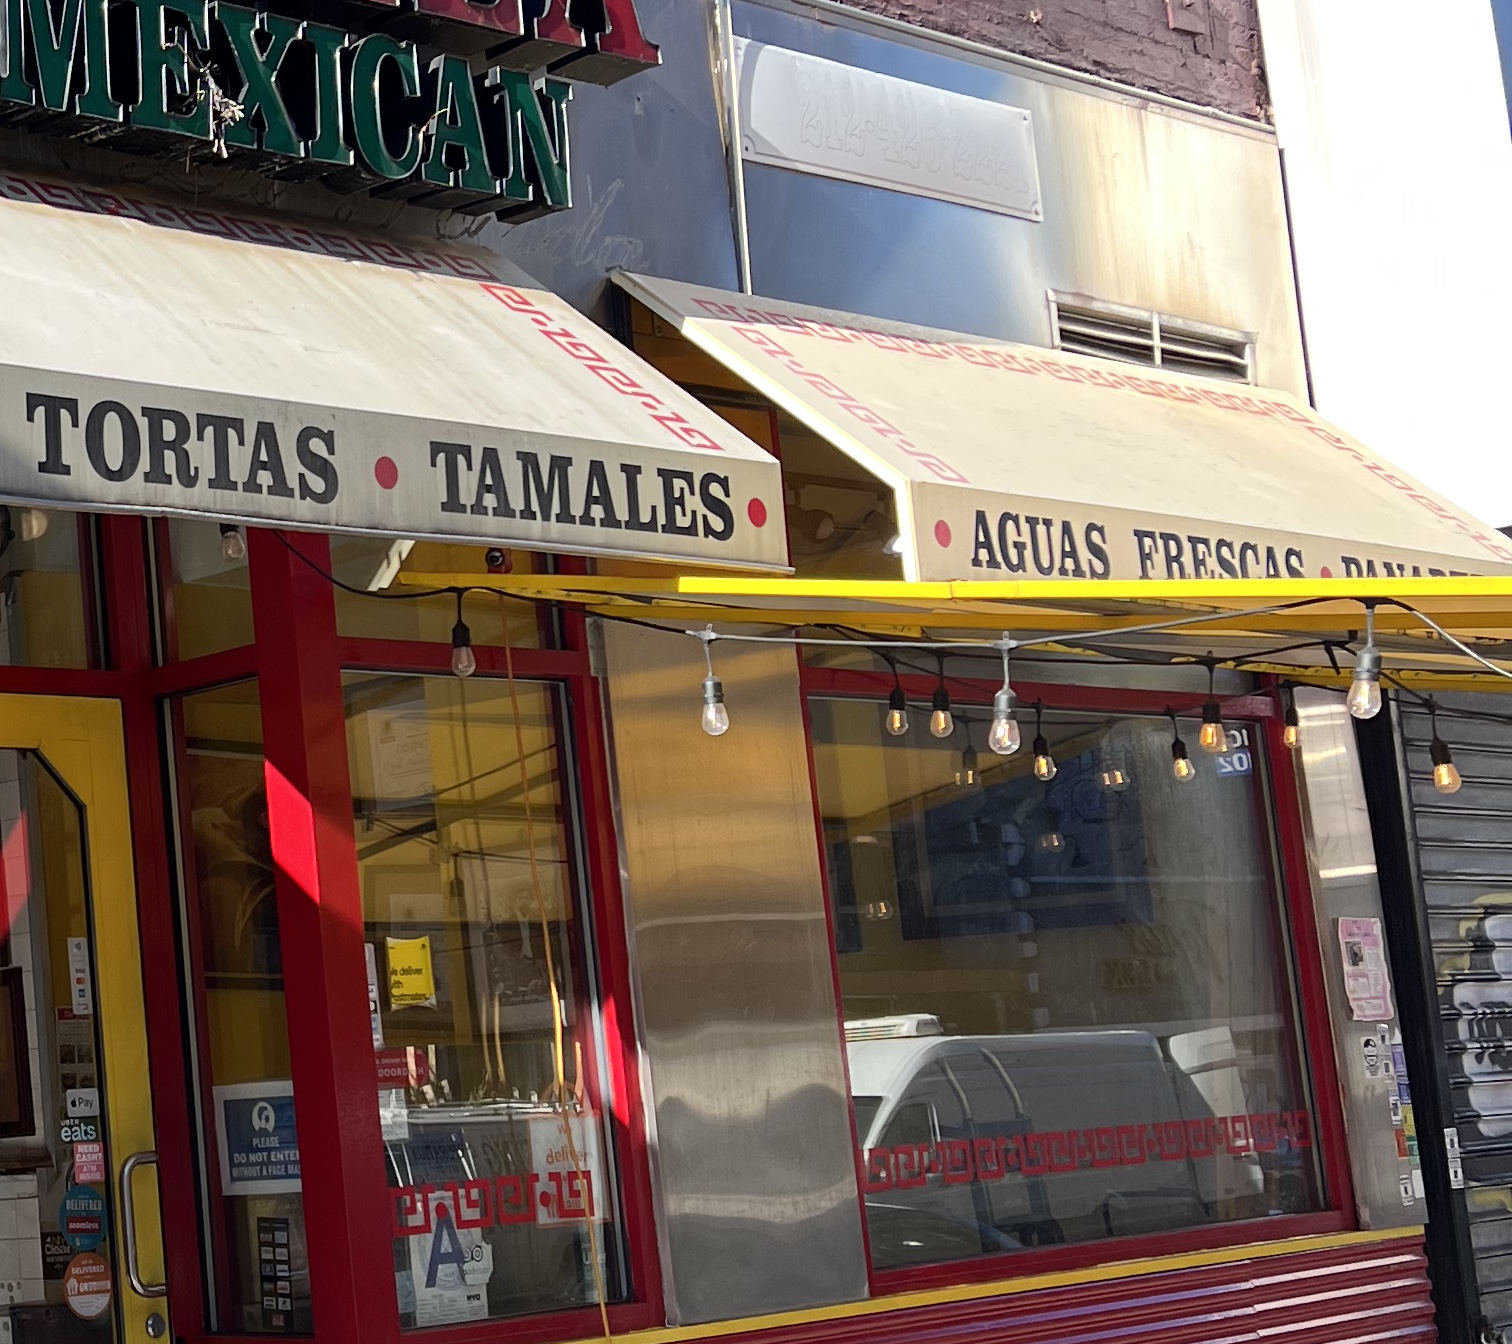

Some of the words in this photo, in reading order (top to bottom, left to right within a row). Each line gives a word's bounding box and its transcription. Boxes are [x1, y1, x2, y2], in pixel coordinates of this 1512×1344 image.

[26, 391, 338, 505] TORTAS
[430, 440, 735, 542] TAMALES
[971, 509, 1112, 579] AGUAS
[78, 1097, 94, 1110] Pay
[60, 1122, 97, 1142] eats
[77, 1144, 100, 1153] NEED
[252, 1136, 280, 1148] PLEASE
[75, 1152, 103, 1162] CASH?
[233, 1153, 247, 1164] DO
[248, 1151, 269, 1163] NOT
[231, 1165, 261, 1177] WITHOUT
[262, 1165, 268, 1176] A
[268, 1164, 287, 1176] FACE
[65, 1199, 103, 1211] DELIVERED
[68, 1221, 99, 1230] seamless
[425, 1204, 466, 1289] A
[71, 1265, 105, 1275] DELIVERED
